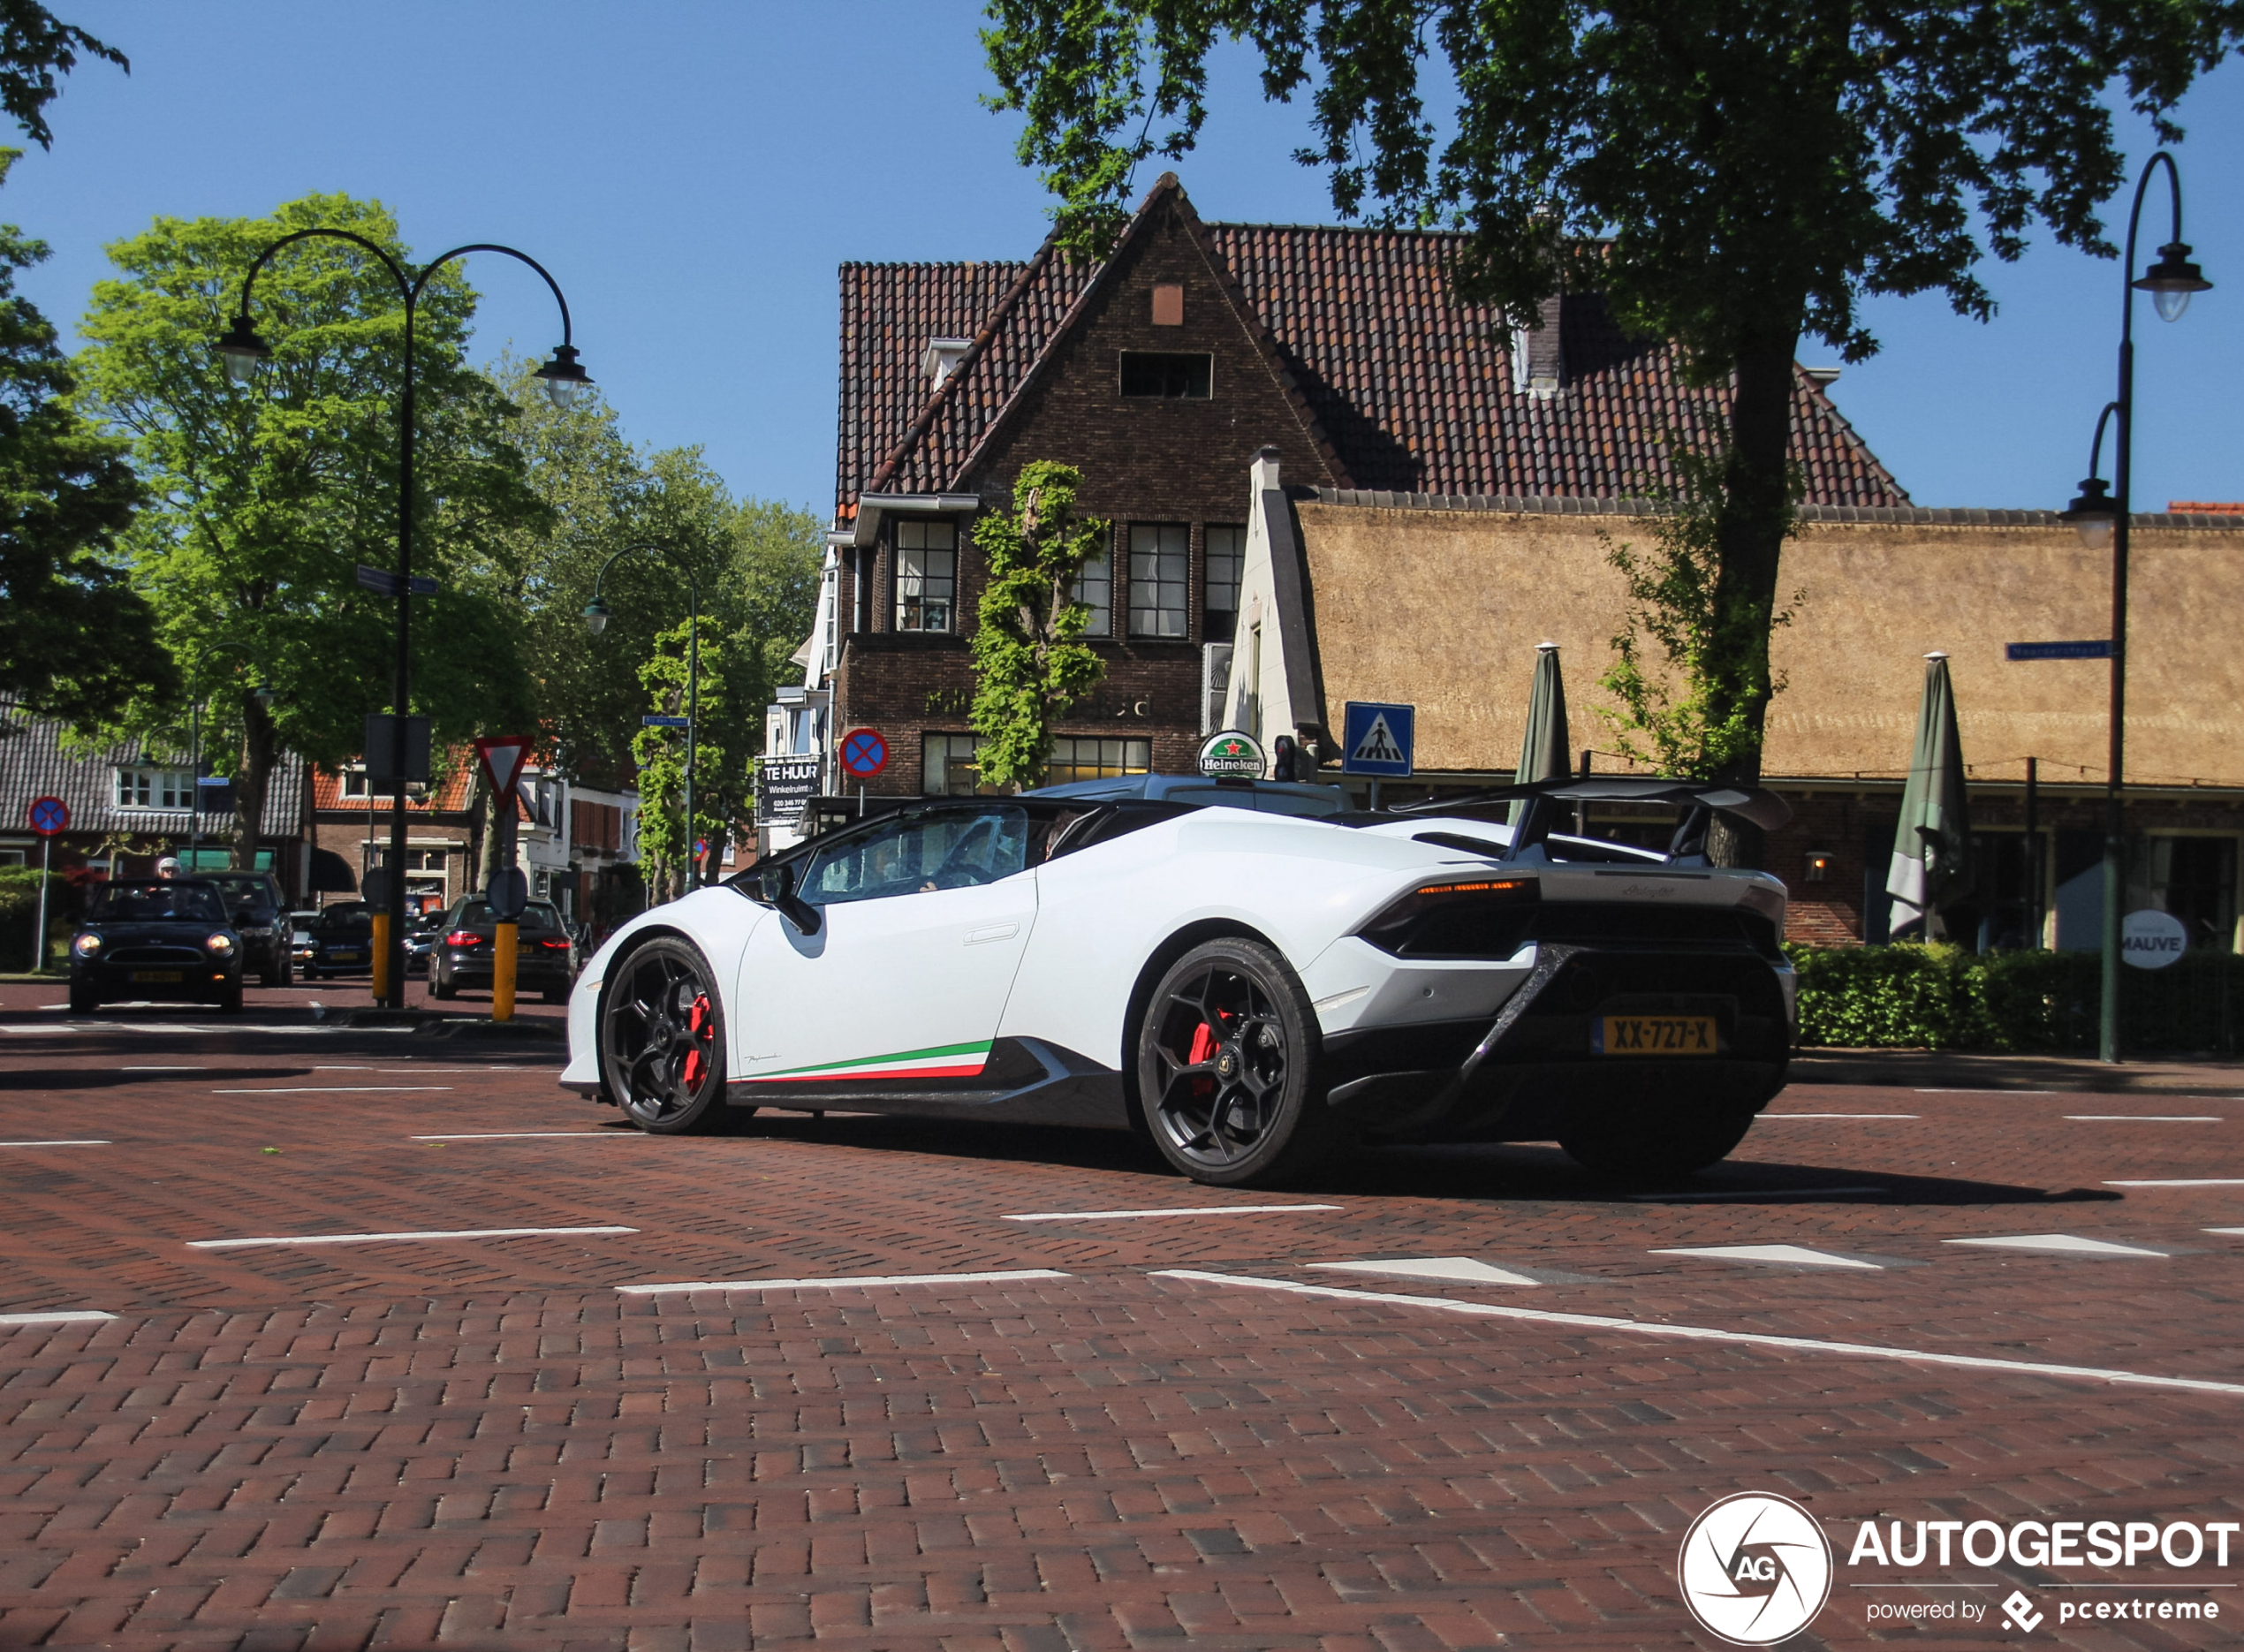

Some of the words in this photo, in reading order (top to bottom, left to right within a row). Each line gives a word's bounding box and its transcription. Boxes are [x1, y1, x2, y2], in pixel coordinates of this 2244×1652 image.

[1204, 760, 1261, 770] Heineken
[765, 767, 780, 780] TE
[783, 765, 817, 779] HUUR
[769, 785, 813, 794] Winkelruimte
[1614, 1020, 1709, 1049] XX-727-X
